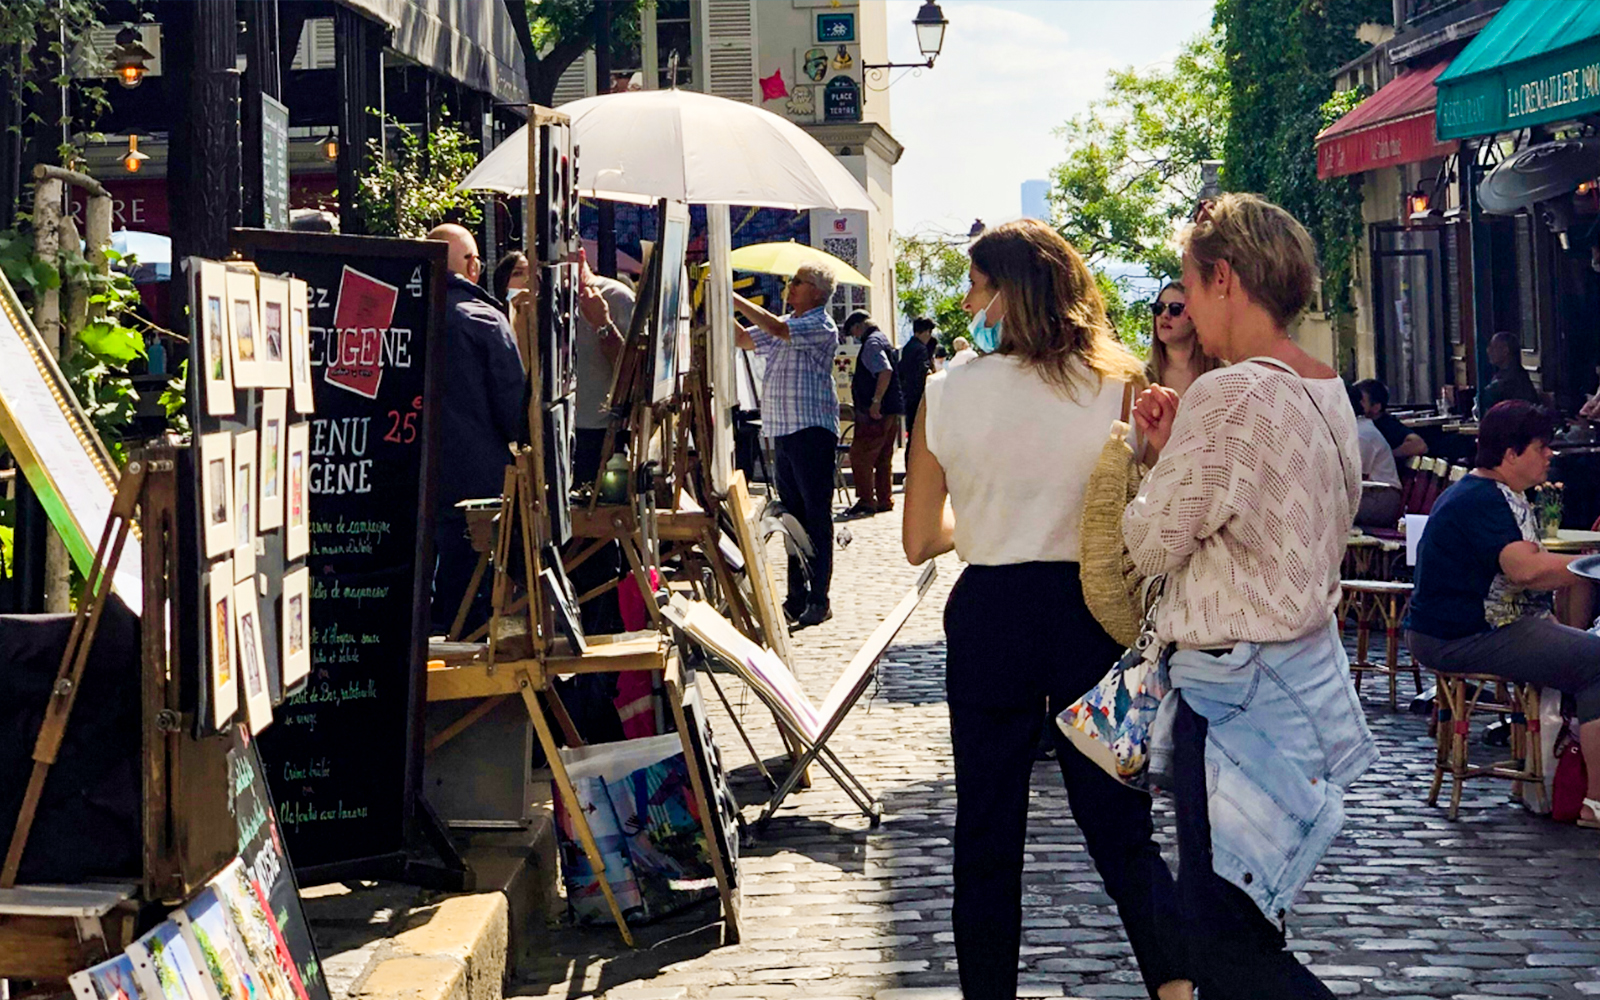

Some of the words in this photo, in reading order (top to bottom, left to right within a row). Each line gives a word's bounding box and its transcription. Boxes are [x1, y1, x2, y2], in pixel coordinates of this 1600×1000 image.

[830, 106, 855, 114] TERTRE
[831, 92, 853, 101] PLACE
[1508, 88, 1519, 117] LA
[313, 417, 371, 457] ENU
[308, 458, 373, 495] GÈNE
